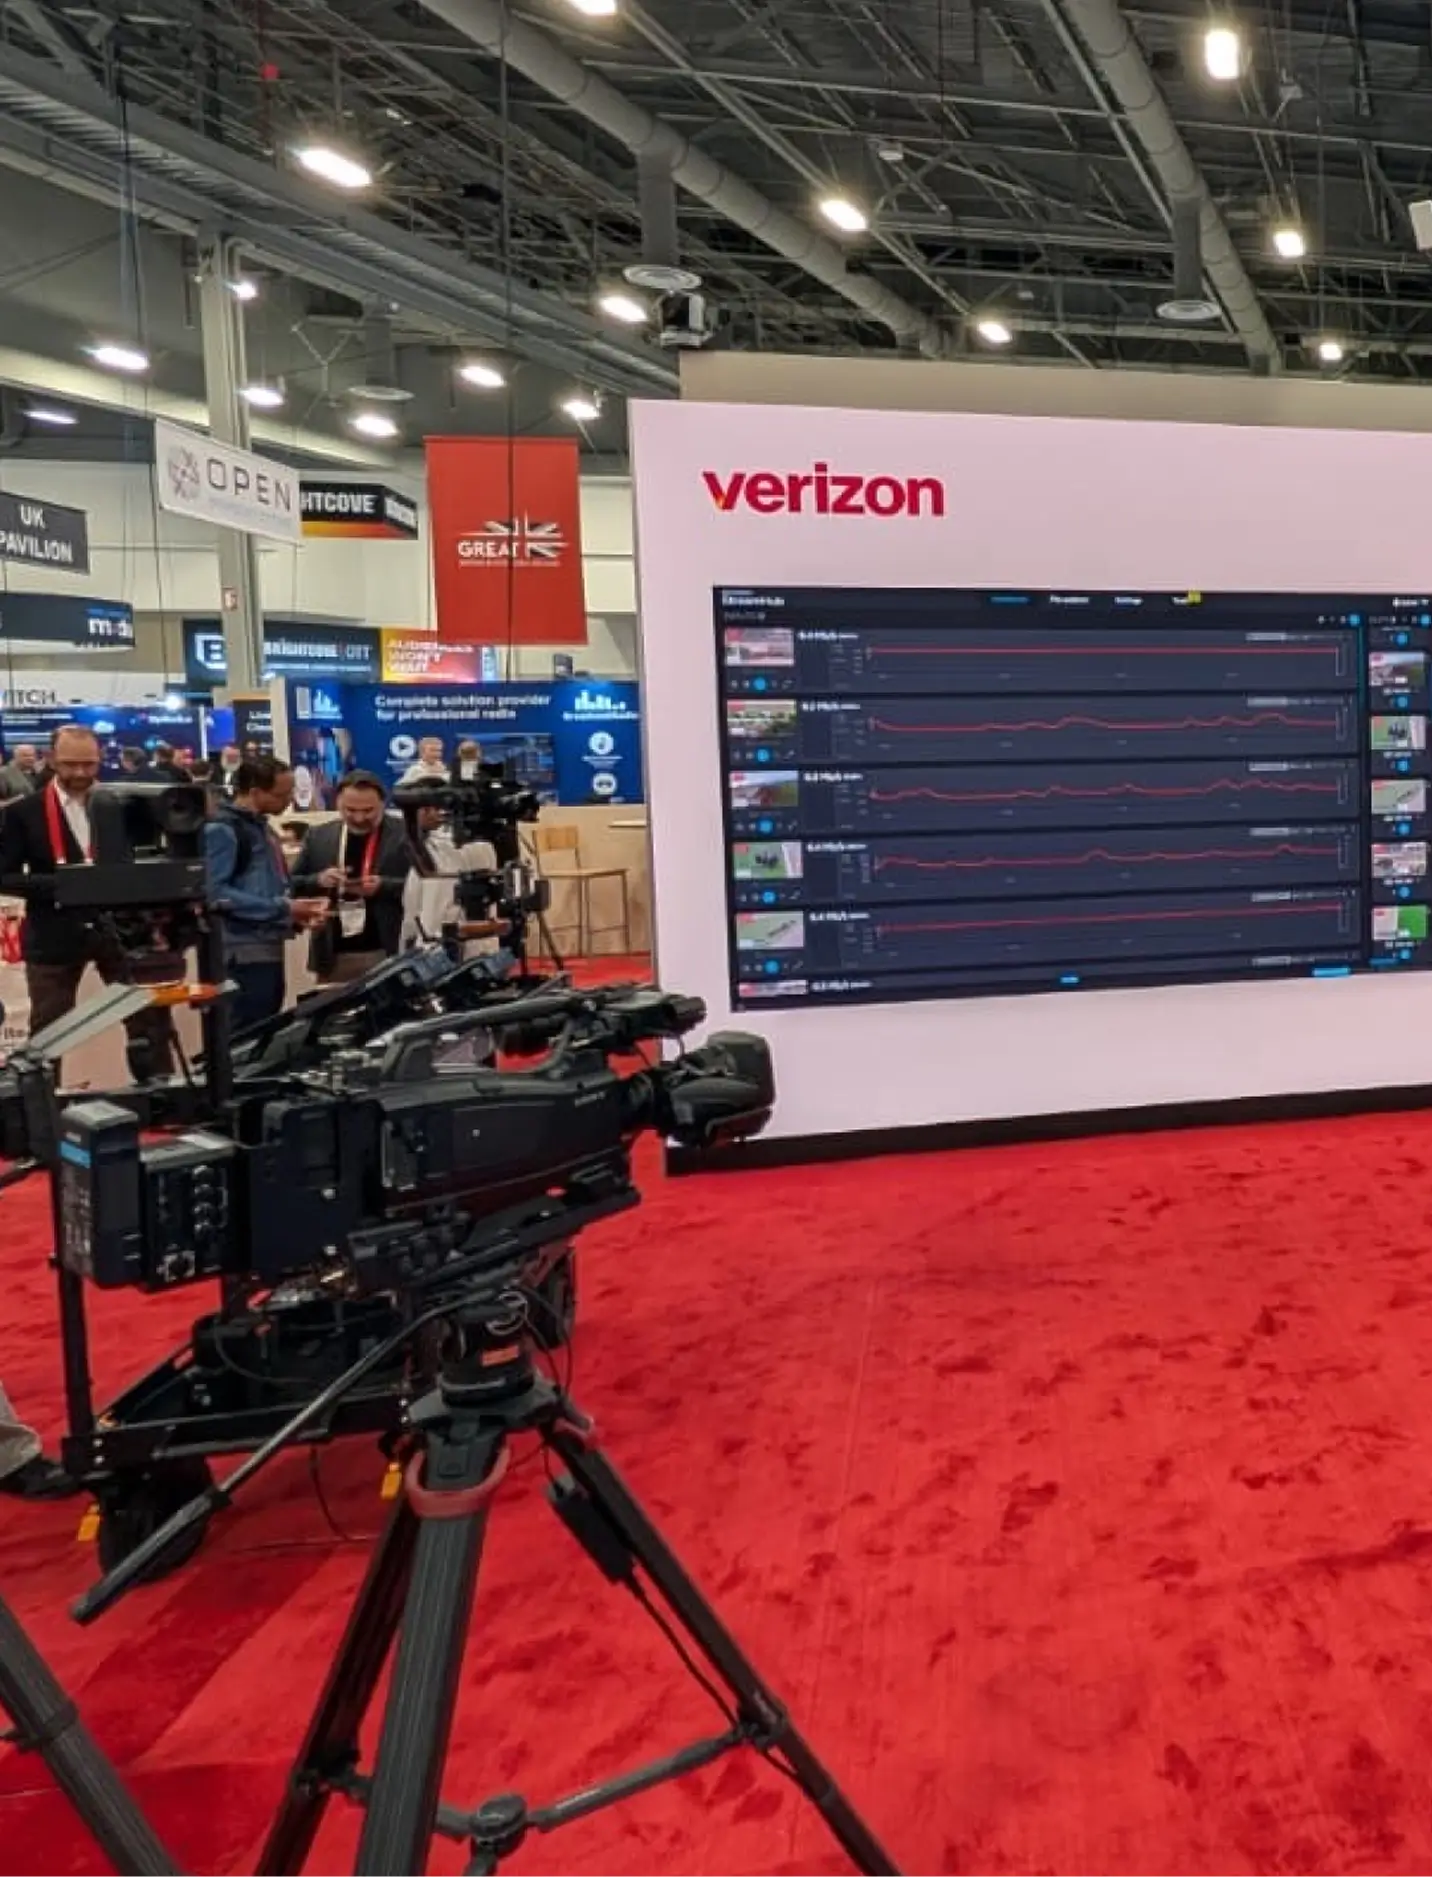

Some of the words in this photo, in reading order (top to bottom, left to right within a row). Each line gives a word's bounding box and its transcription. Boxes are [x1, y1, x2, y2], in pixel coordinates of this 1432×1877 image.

[206, 457, 292, 513] OPEN
[701, 461, 945, 517] verizon
[20, 503, 46, 530] UK
[457, 539, 519, 559] GREAT
